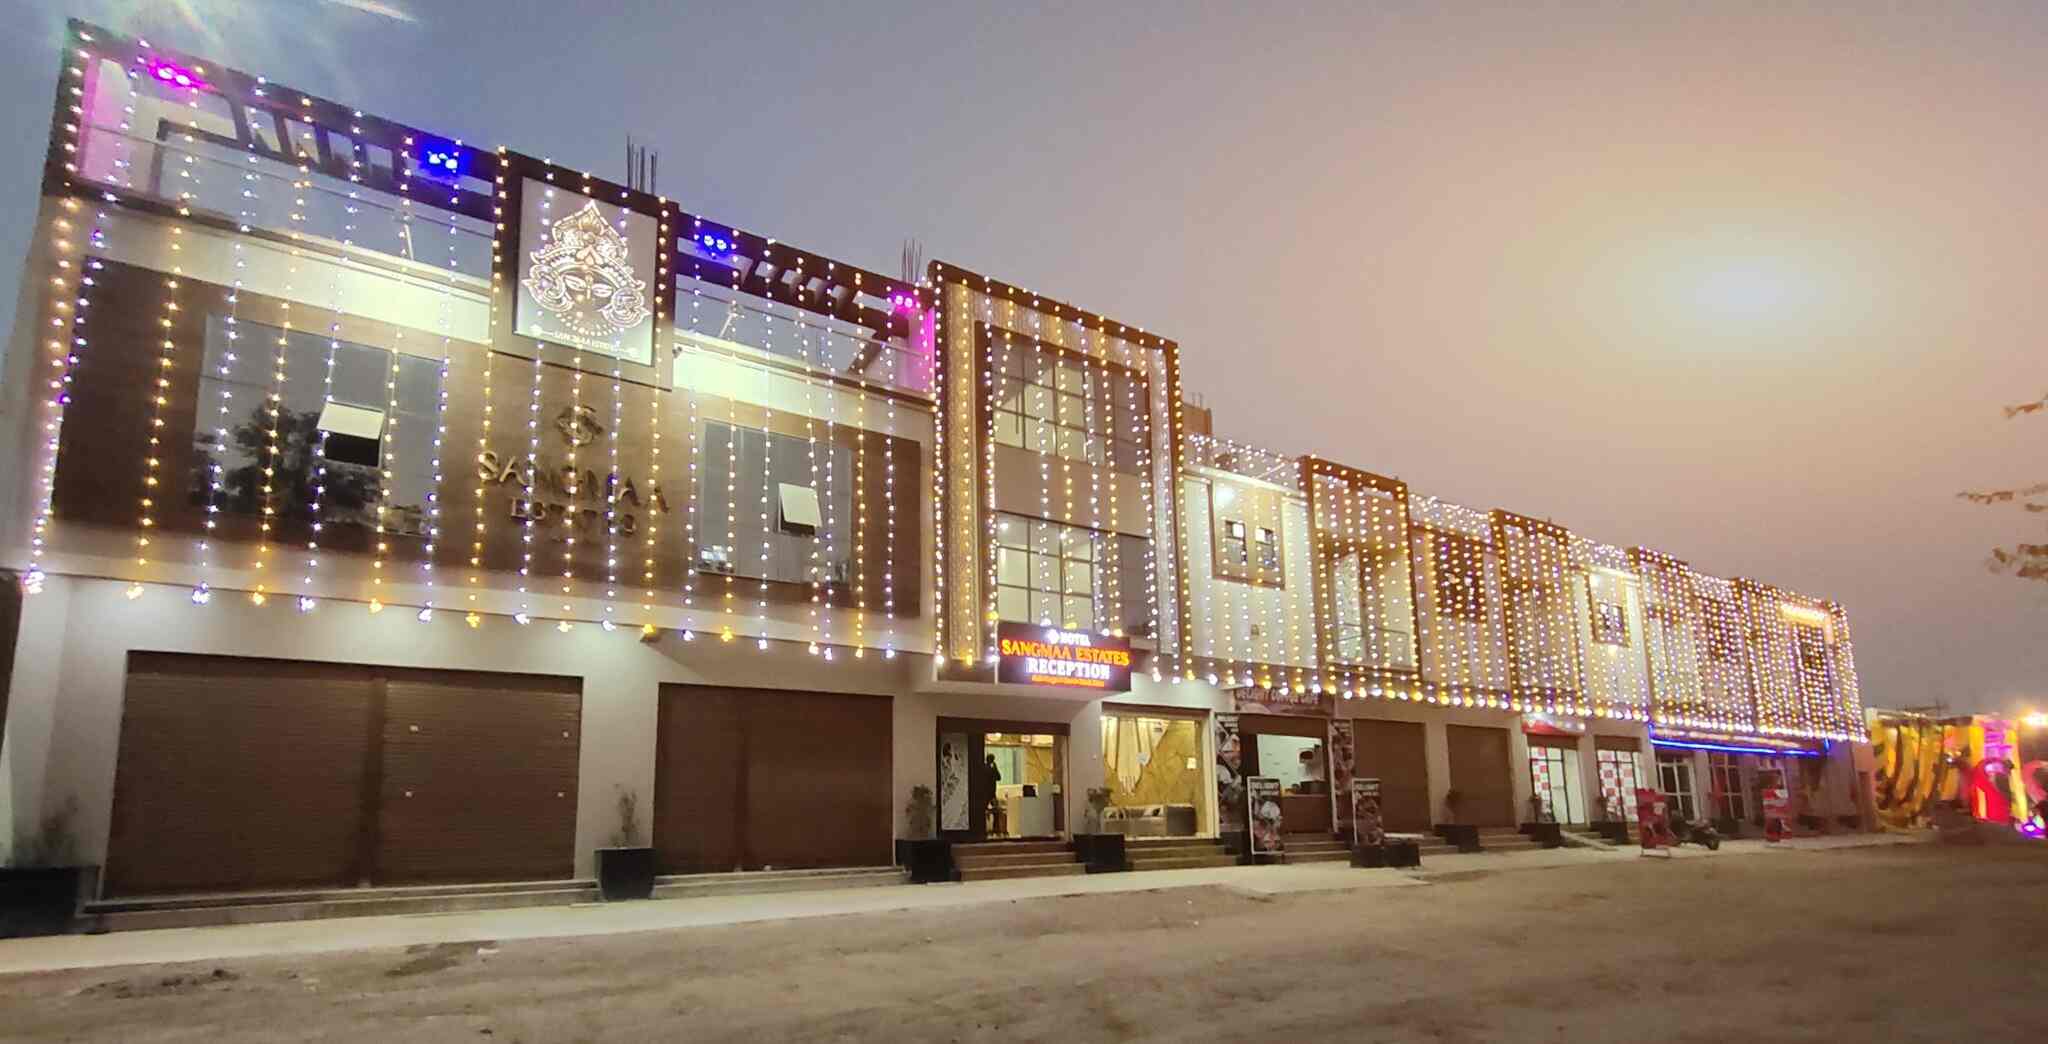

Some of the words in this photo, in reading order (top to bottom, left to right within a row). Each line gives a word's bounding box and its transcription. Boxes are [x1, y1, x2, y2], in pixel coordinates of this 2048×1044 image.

[1060, 631, 1091, 647] HOTEL
[1001, 638, 1072, 661] SANGMAA
[1075, 646, 1130, 666] ESTATES
[1025, 657, 1111, 680] RECEPTION
